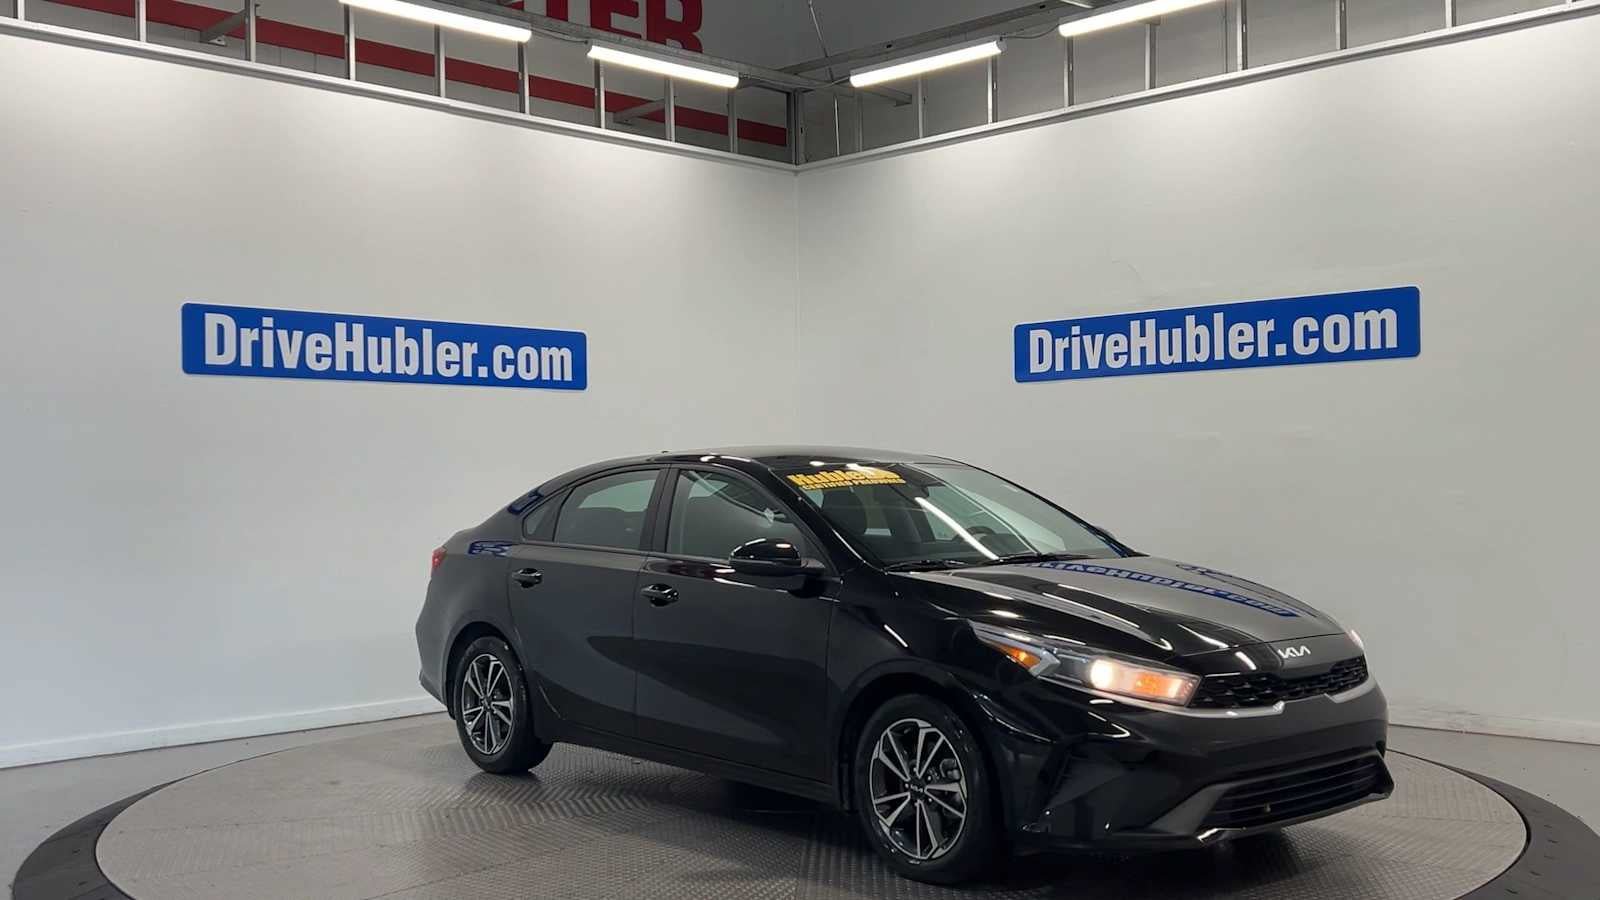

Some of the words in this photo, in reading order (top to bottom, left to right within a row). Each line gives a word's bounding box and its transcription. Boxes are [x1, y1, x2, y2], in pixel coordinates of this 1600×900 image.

[204, 312, 573, 381] DriveHubler.com
[1029, 307, 1398, 374] DriveHubler.com
[1277, 645, 1311, 659] KIA
